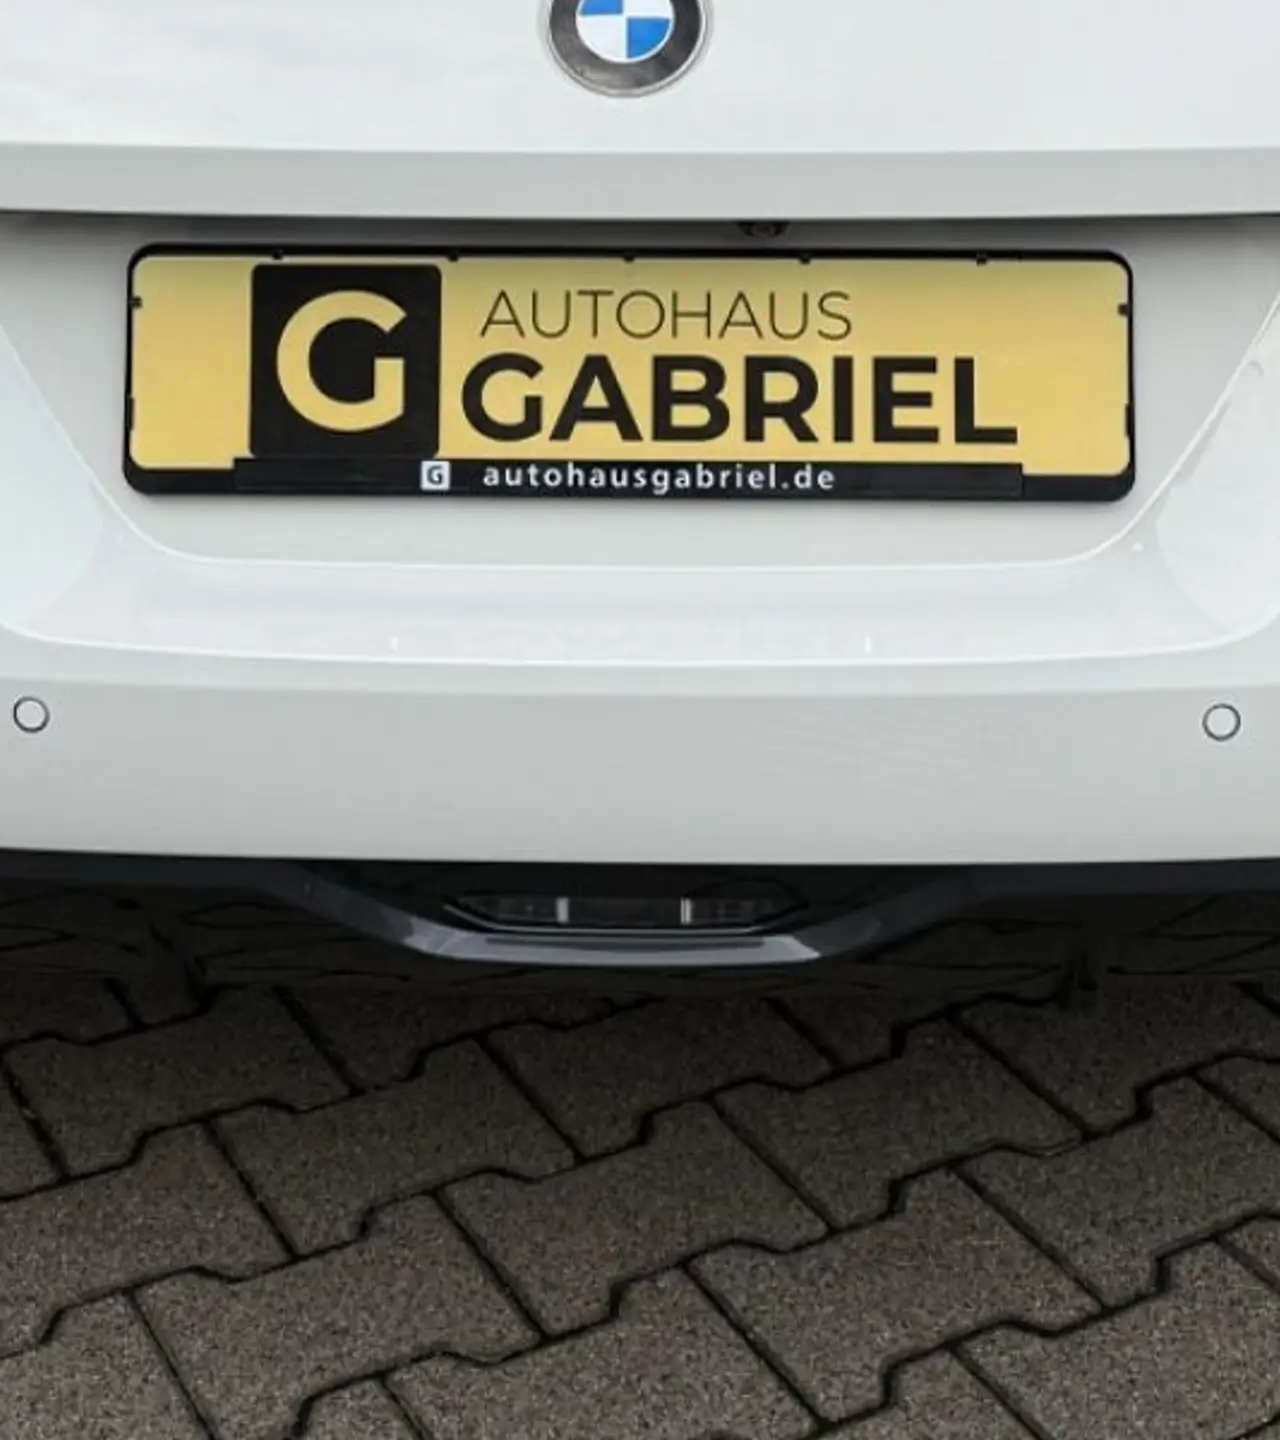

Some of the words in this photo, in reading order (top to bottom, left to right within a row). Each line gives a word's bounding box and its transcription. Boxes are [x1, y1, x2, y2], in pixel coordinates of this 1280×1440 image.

[479, 289, 852, 341] AUTOHAUS
[276, 289, 408, 433] G
[461, 351, 1019, 445] GABRIEL
[483, 462, 835, 495] autohausgabriel.de
